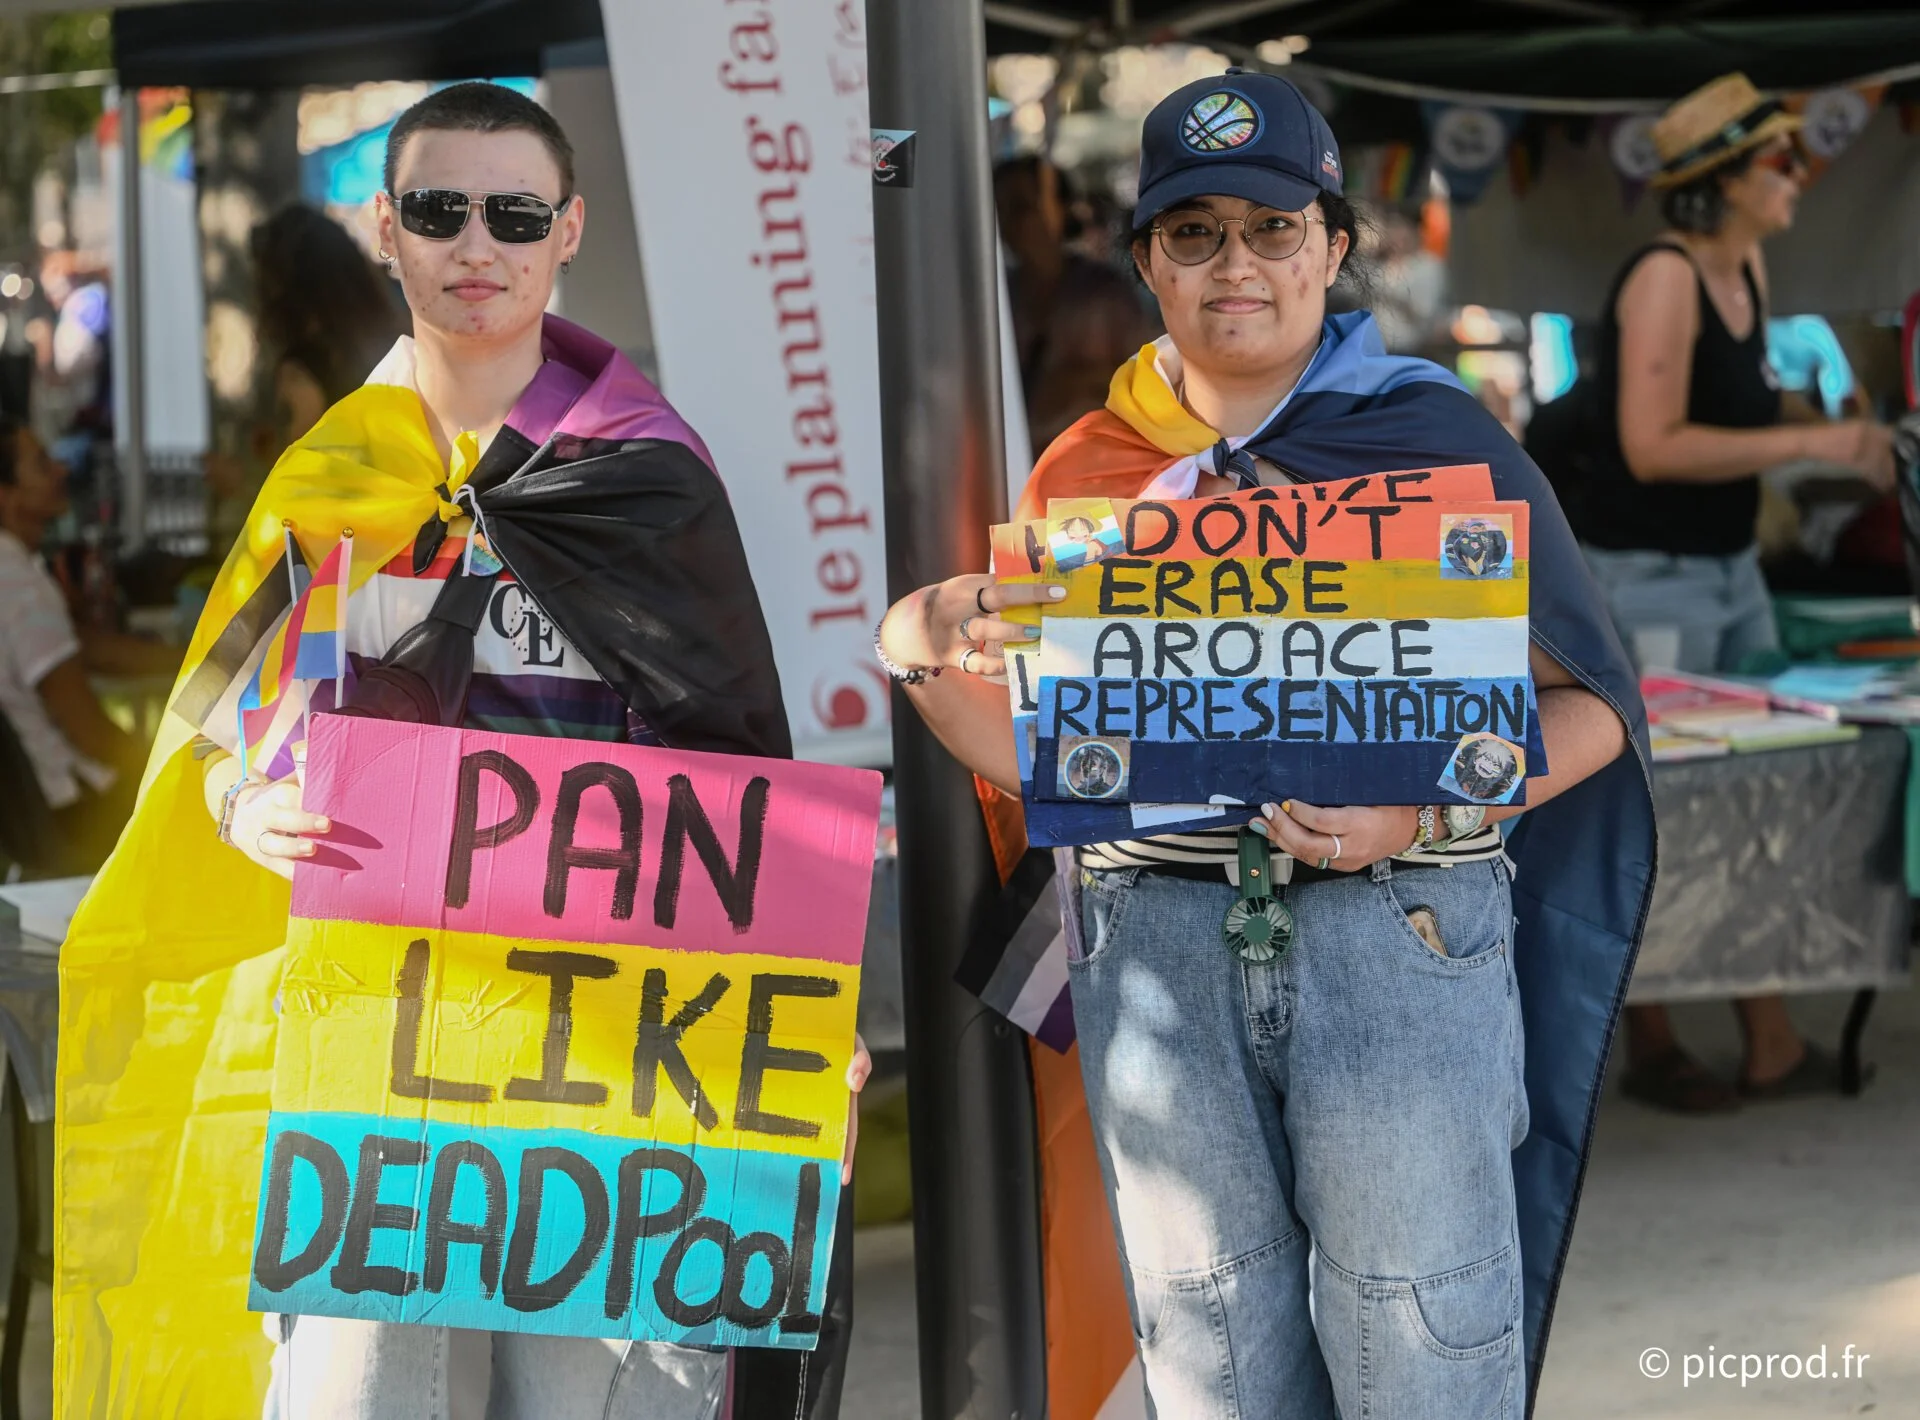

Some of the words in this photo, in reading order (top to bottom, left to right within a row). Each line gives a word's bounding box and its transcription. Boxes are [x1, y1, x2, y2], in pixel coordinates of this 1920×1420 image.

[717, 0, 784, 96] fa
[746, 115, 871, 534] planning
[1125, 500, 1402, 561] DON'T
[810, 549, 868, 630] le
[1098, 558, 1349, 616] ERASE
[1053, 677, 1526, 740] REPRESENTATION
[444, 749, 772, 934] PAN
[389, 938, 842, 1139] LIKE
